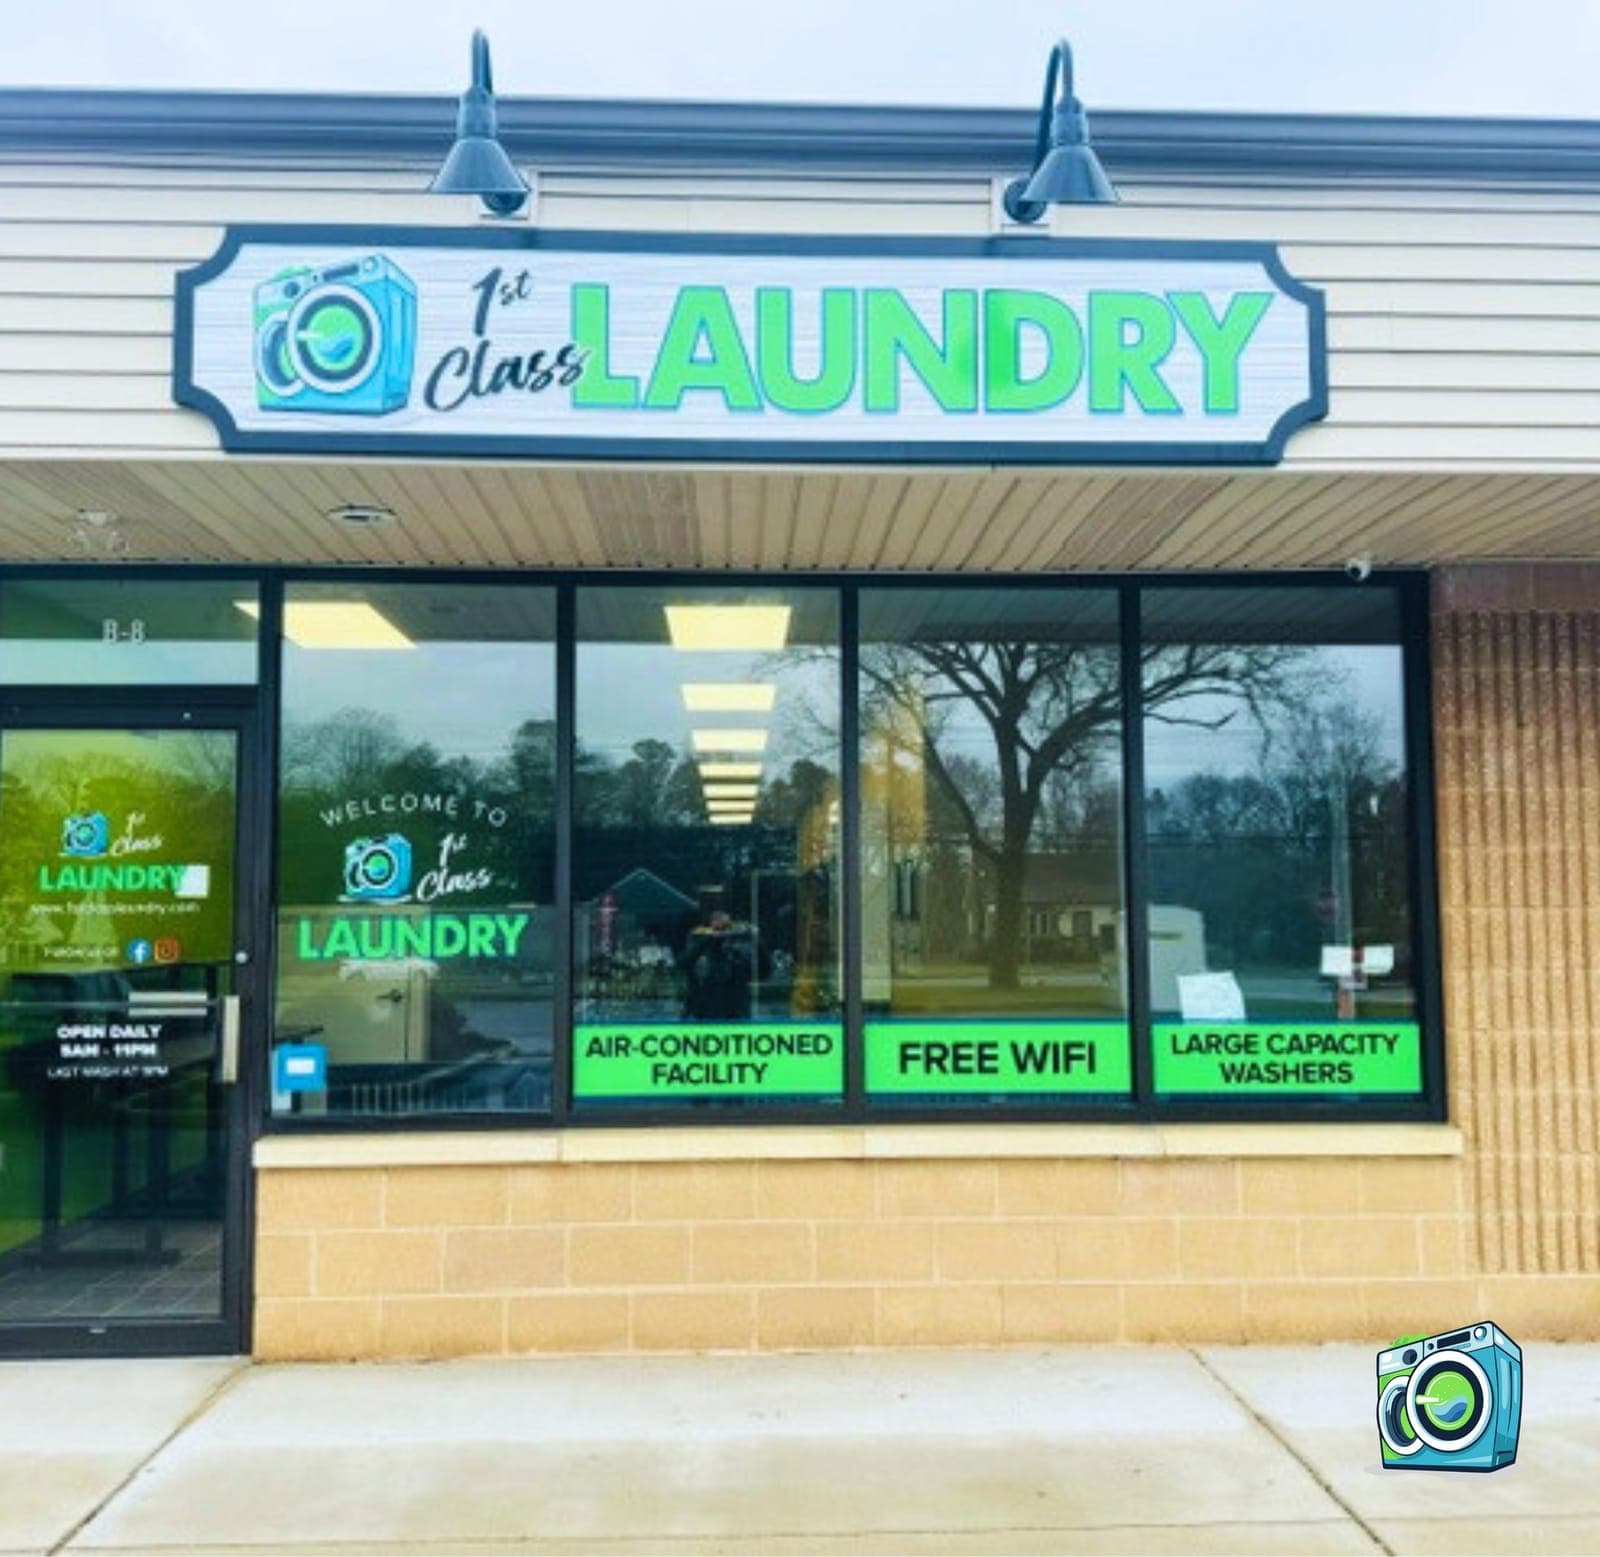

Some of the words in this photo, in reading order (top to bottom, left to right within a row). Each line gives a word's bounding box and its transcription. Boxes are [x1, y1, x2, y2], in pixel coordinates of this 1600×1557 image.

[471, 267, 531, 337] 1st
[571, 283, 1274, 415] LAUNDRY
[423, 341, 591, 412] Class
[320, 793, 458, 827] WELCOME
[475, 801, 507, 827] TO
[438, 833, 467, 867] 1st
[39, 864, 187, 891] LAUNDRY
[416, 867, 493, 901] Class
[298, 913, 528, 960] LAUNDRY
[57, 1024, 106, 1039] OPEN
[109, 1024, 162, 1039] DAILY
[586, 1033, 833, 1058] AIR-CONDITIONED
[1171, 1034, 1259, 1055] LARGE
[1266, 1033, 1399, 1055] CAPACITY
[652, 1062, 767, 1084] FACILITY
[899, 1042, 1002, 1075] FREE
[1011, 1041, 1096, 1074] WIFI
[1219, 1061, 1353, 1084] WASHERS
